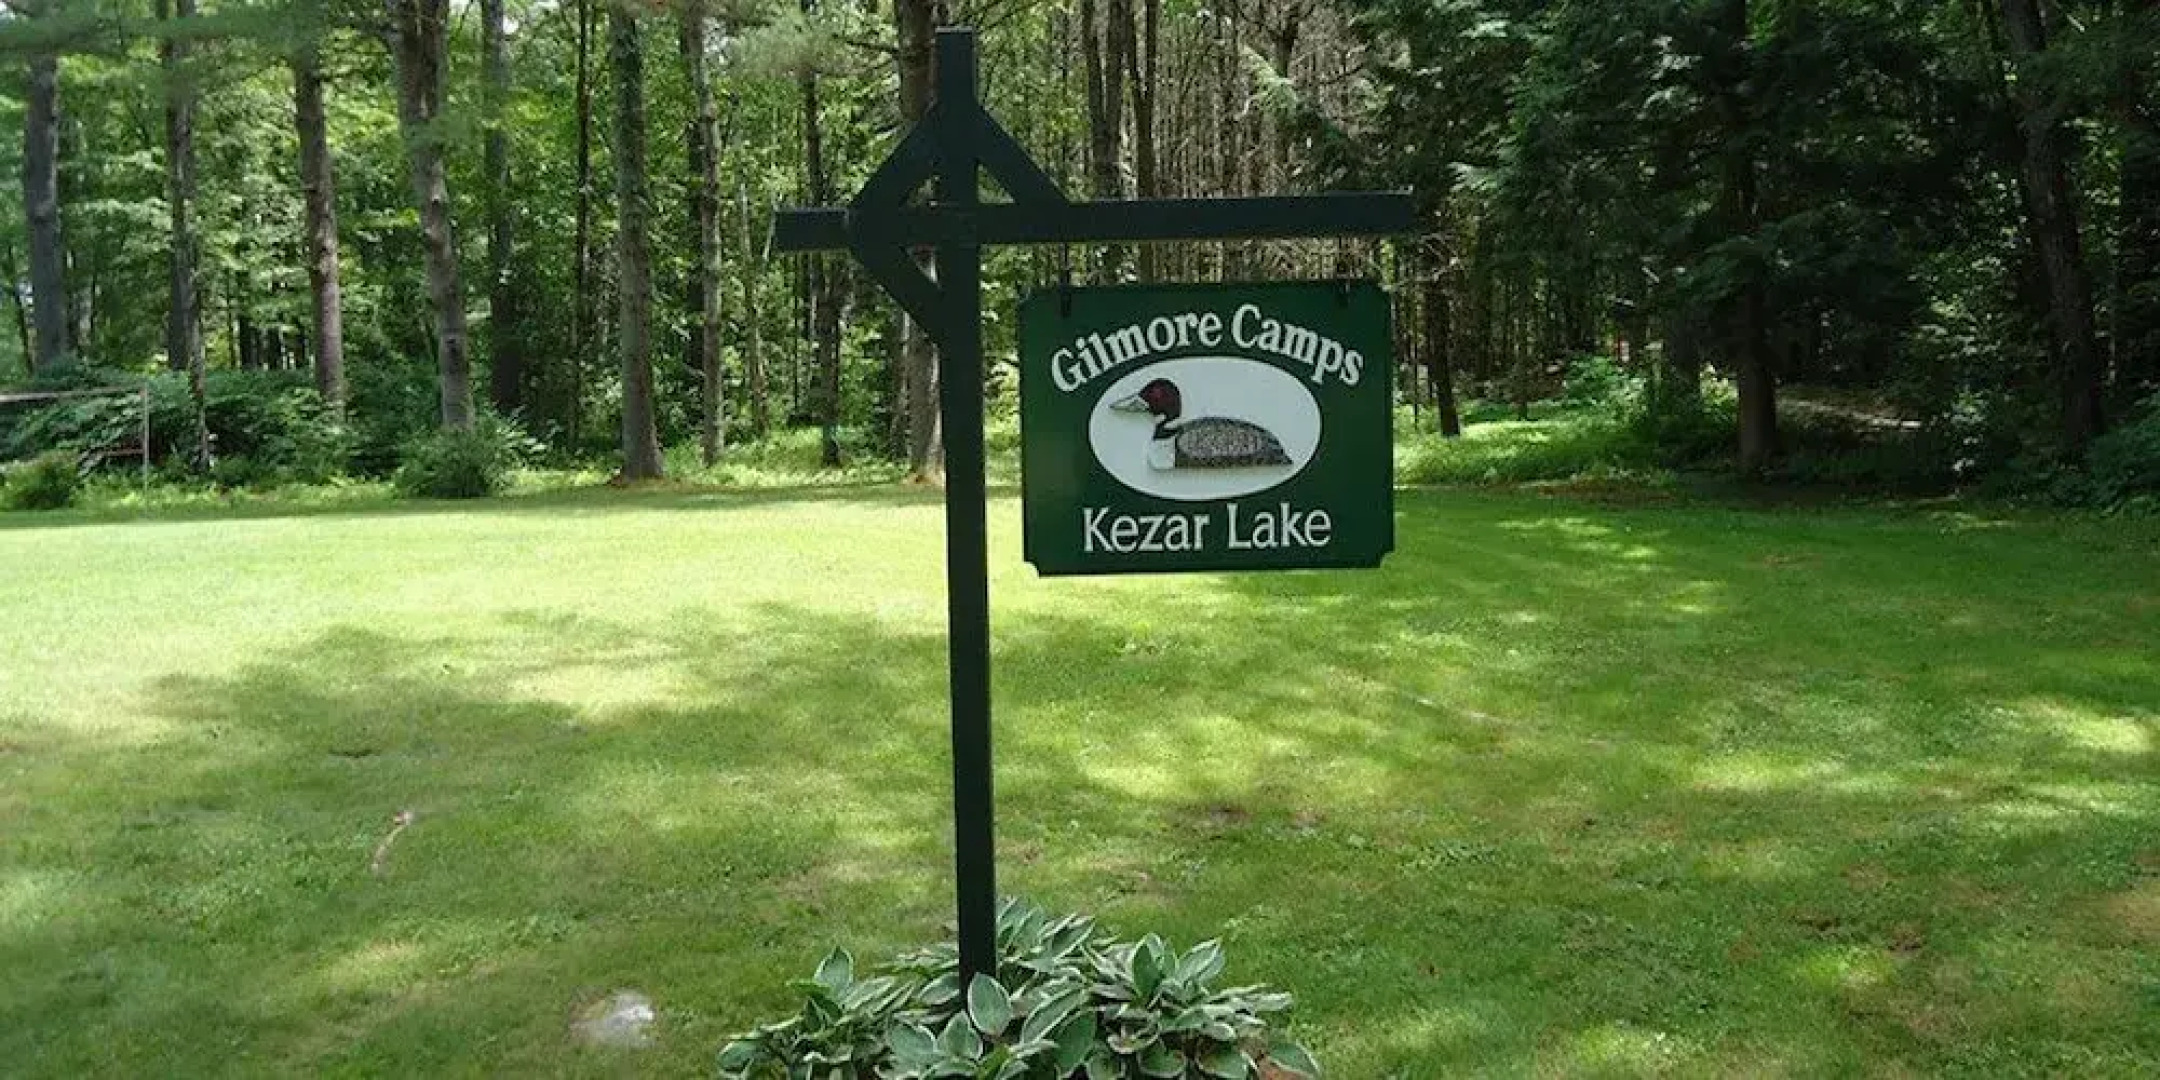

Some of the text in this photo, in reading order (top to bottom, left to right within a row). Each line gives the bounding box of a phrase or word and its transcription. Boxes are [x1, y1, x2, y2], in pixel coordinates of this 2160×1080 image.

[1051, 304, 1364, 392] Gilmore Camps
[1083, 502, 1332, 552] Kezar Lake
